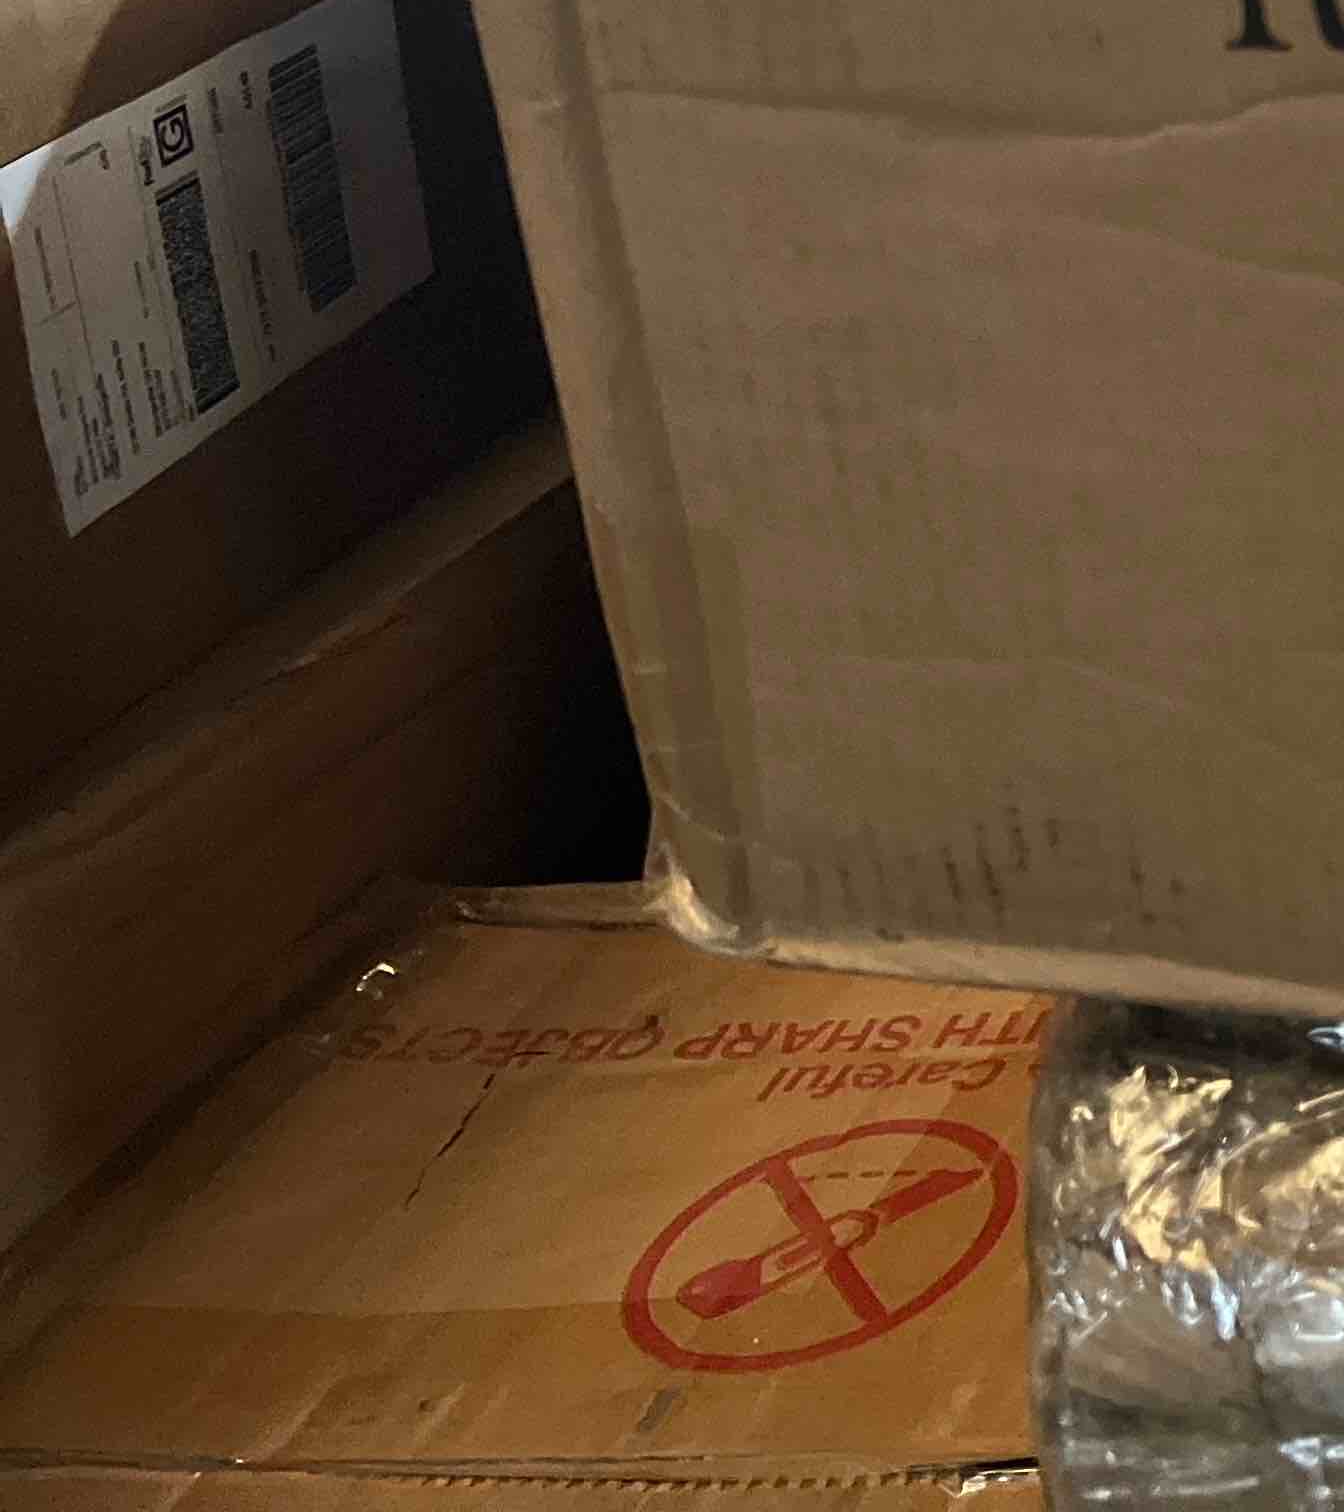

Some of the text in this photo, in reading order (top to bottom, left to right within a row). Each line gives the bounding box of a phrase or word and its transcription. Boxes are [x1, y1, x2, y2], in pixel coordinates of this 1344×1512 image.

[673, 1014, 922, 1061] SHARP
[932, 1005, 1053, 1049] ITH
[756, 1052, 1008, 1103] Careful
